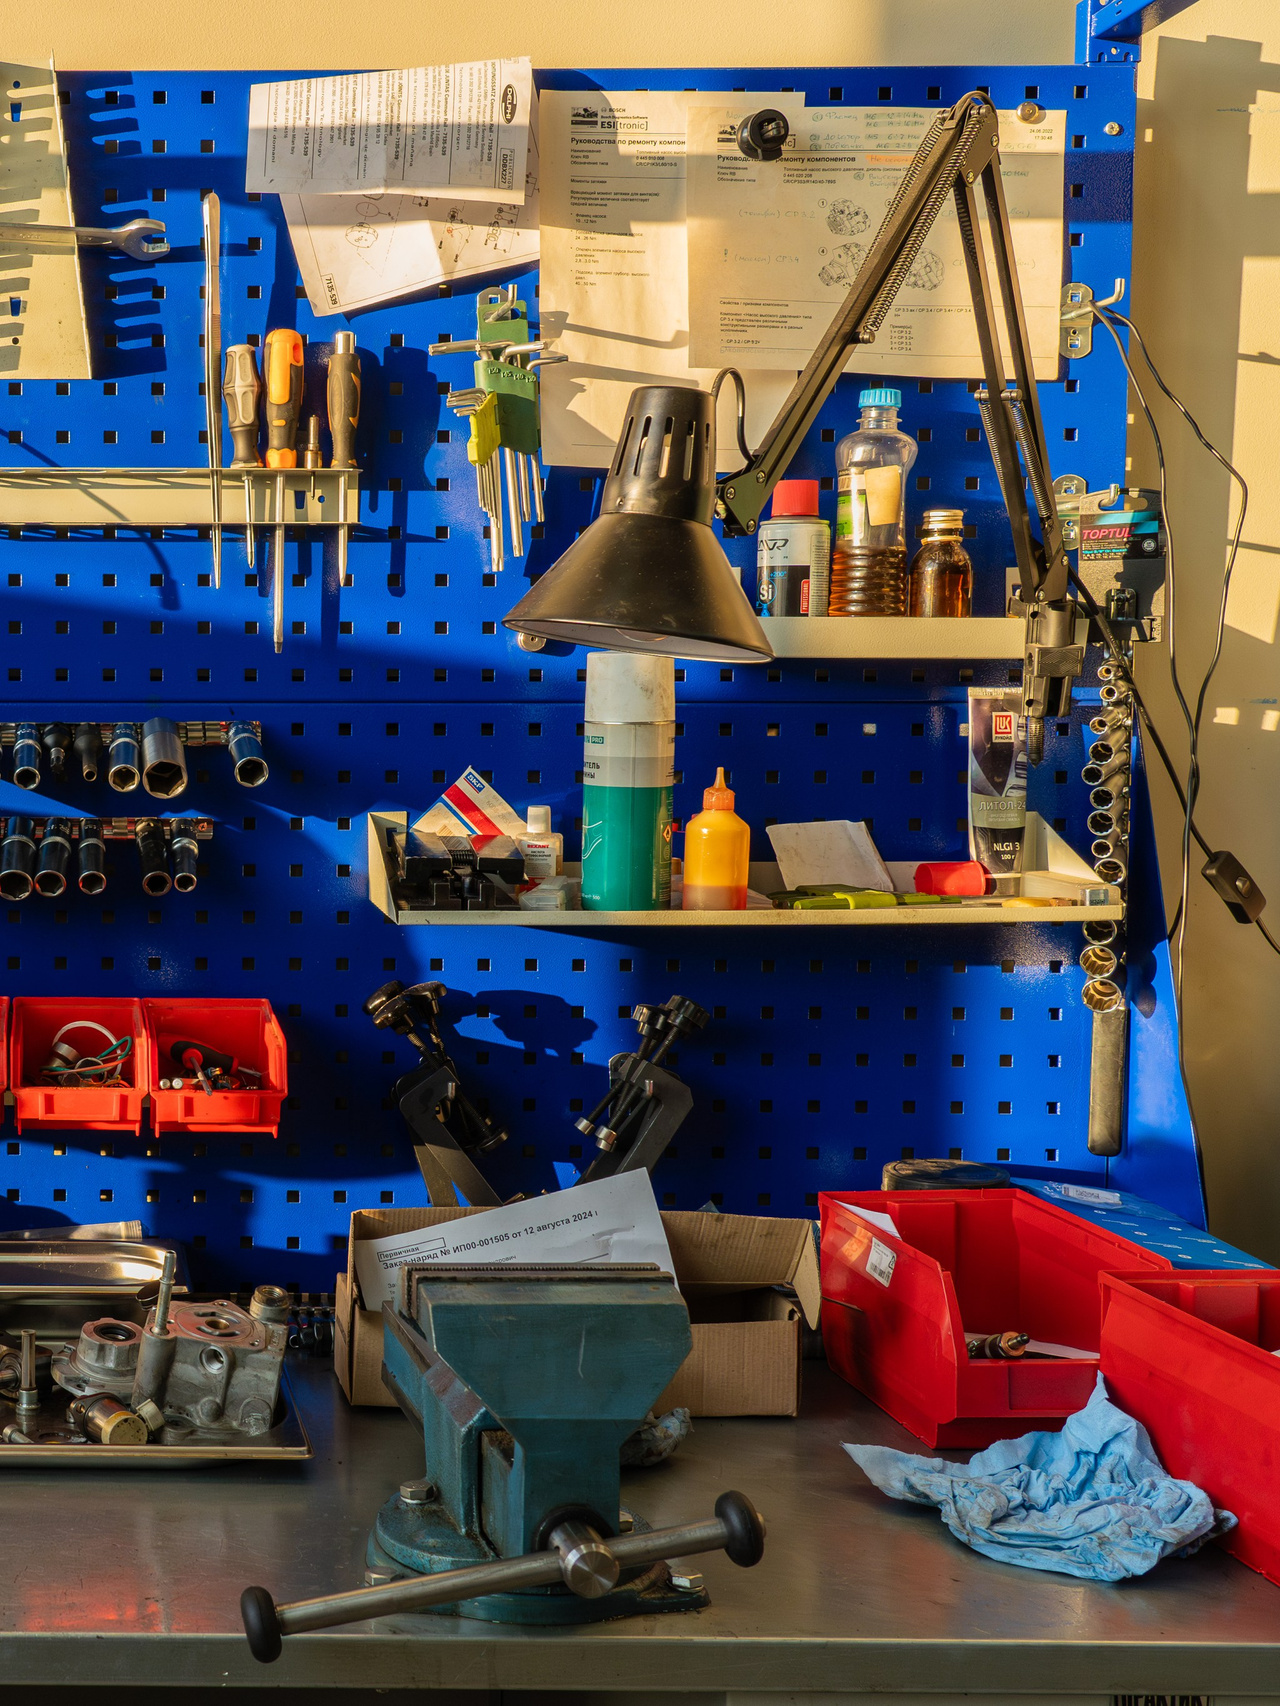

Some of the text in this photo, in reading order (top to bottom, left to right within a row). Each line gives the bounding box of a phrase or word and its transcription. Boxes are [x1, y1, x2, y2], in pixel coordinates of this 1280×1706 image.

[600, 121, 648, 130] ESI[tronic]
[325, 277, 338, 305] 7135-539
[1082, 528, 1132, 539] TOPTUL
[760, 586, 772, 600] Si
[467, 774, 484, 789] SKF
[979, 802, 1026, 811] ЛИТОЛ-24
[1014, 842, 1020, 850] 3
[452, 1233, 510, 1254] ИП00-001505
[512, 1230, 522, 1239] от
[524, 1227, 535, 1236] 12
[535, 1217, 571, 1234] августа
[572, 1210, 593, 1222] 2024
[380, 1246, 420, 1260] Первичная
